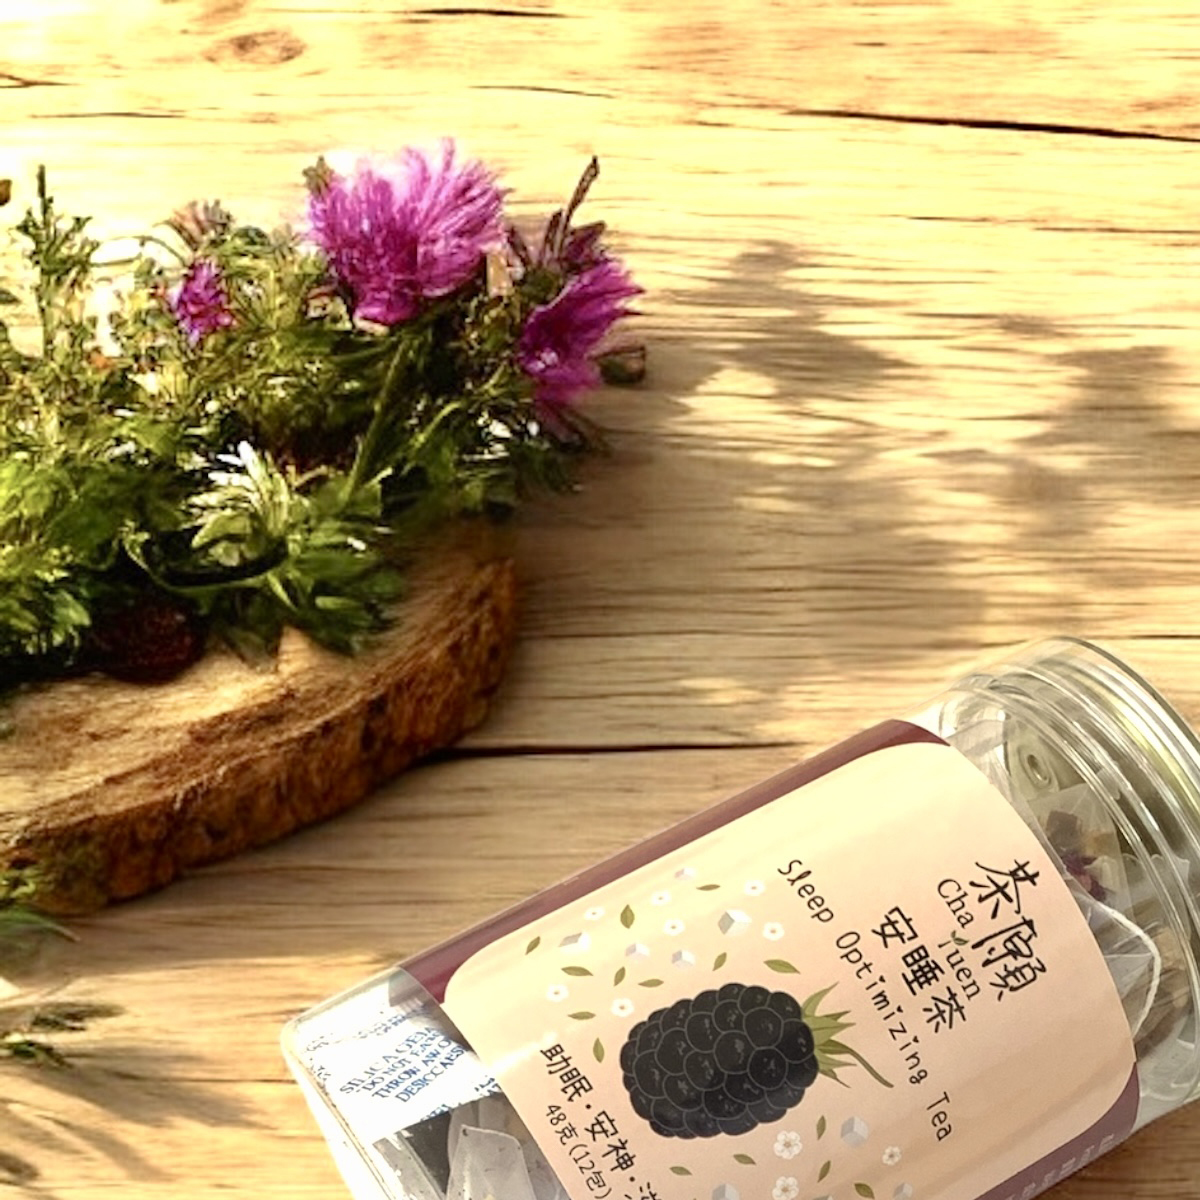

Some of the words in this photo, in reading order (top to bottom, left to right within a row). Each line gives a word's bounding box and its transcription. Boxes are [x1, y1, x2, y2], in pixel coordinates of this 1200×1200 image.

[937, 878, 974, 929] Cha
[777, 859, 834, 923] Sleep
[835, 931, 928, 1085] Optimizing
[926, 1091, 953, 1142] Tea
[871, 906, 967, 1034] 安睡茶
[937, 930, 981, 1001] Yuen
